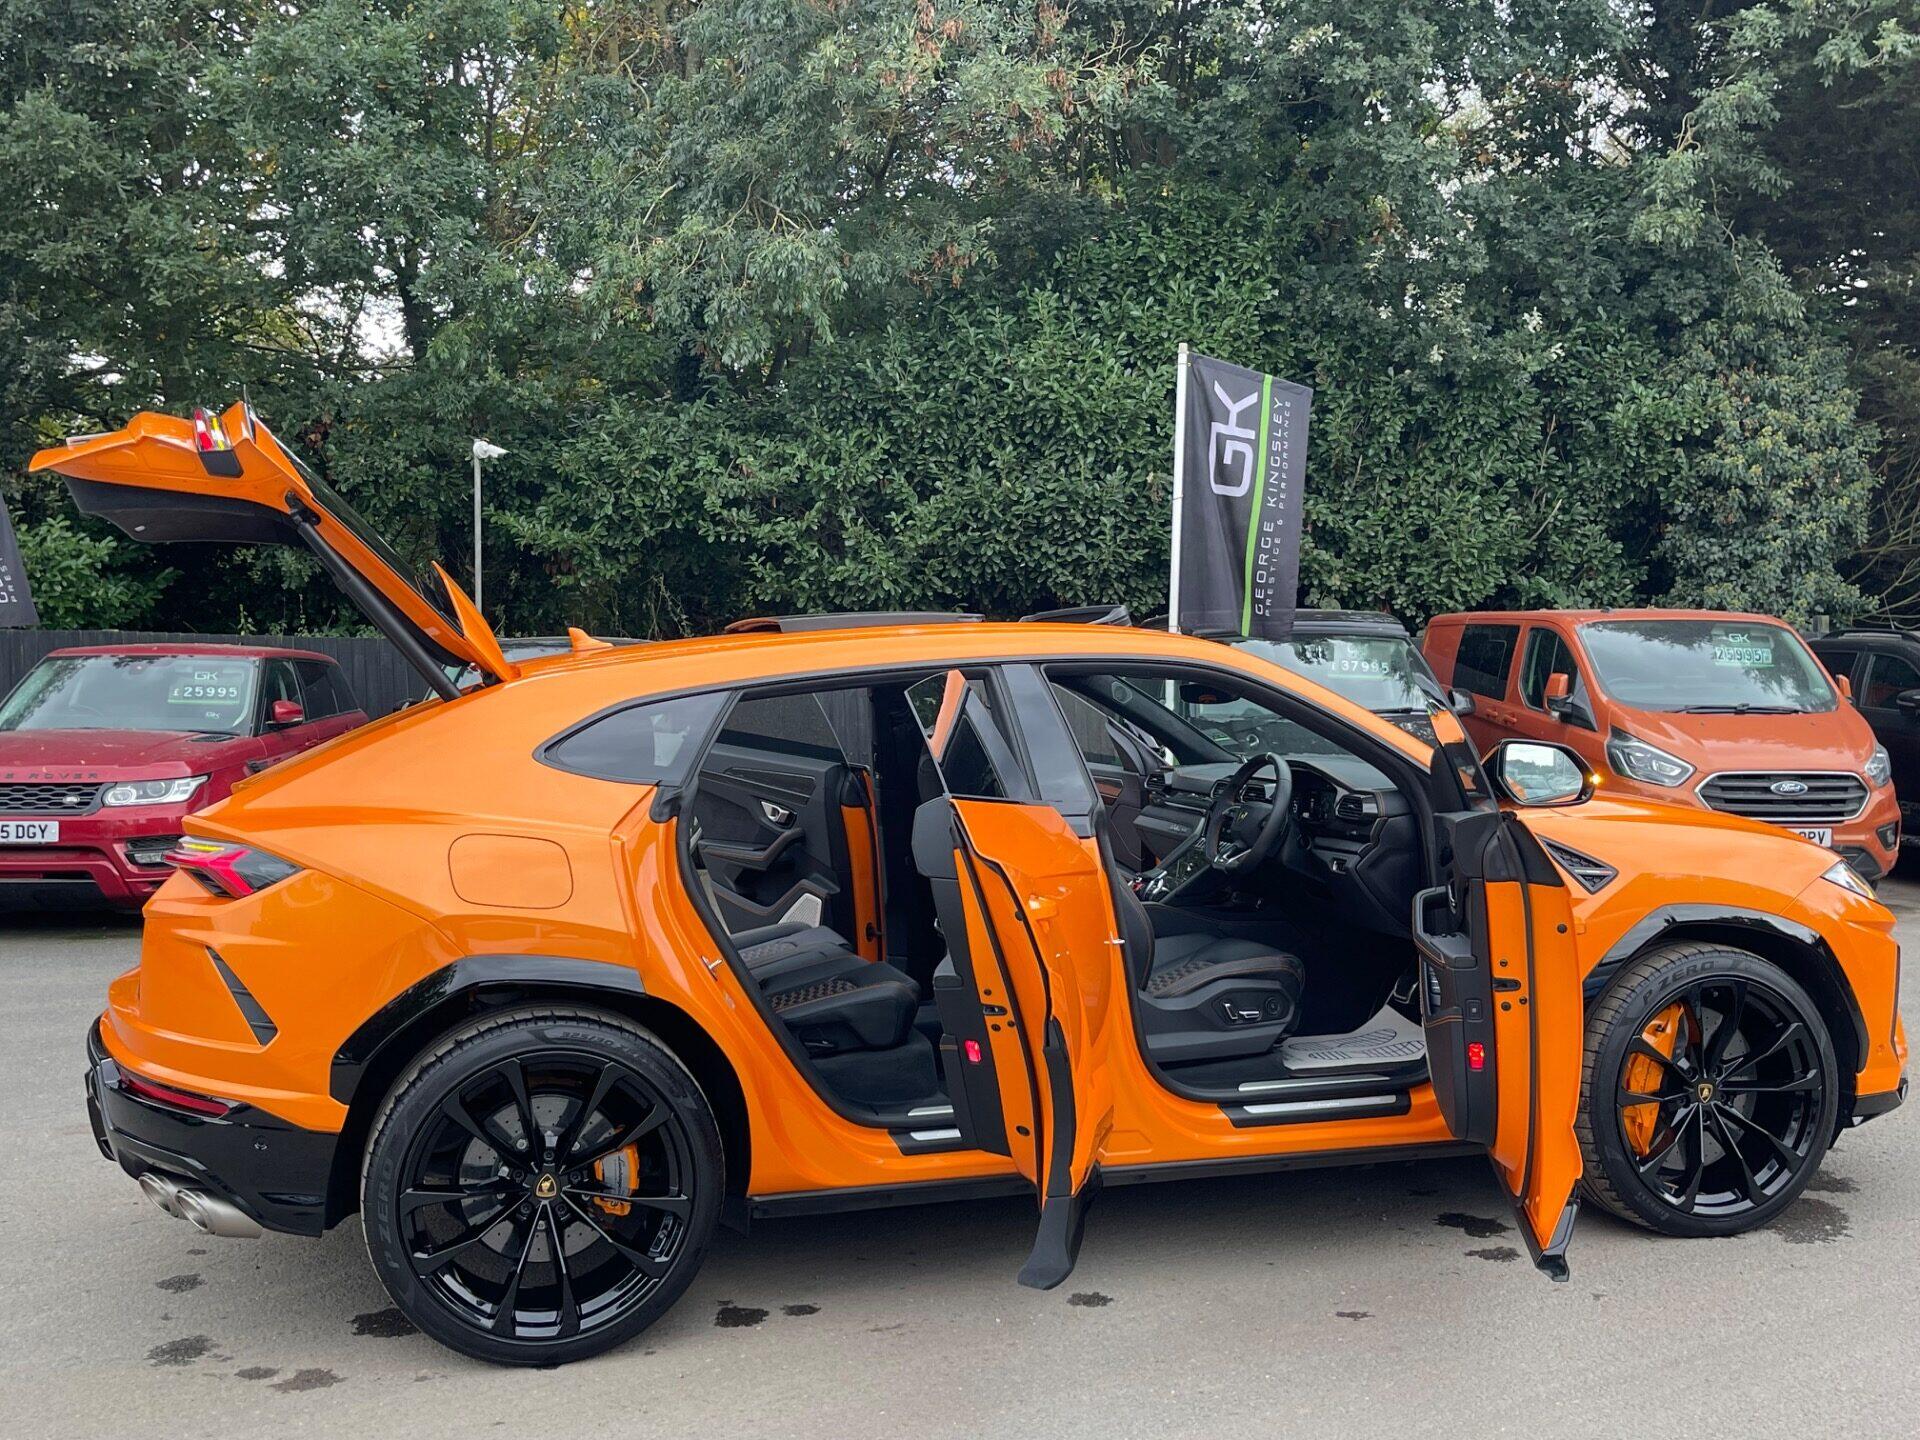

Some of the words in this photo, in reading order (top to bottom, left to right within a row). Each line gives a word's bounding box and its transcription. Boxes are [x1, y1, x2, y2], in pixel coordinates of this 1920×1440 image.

[1209, 380, 1258, 497] GK
[1255, 521, 1274, 615] GEORGE
[1266, 397, 1284, 507] KINGSLEY
[1265, 538, 1281, 616] PRESTIGE
[1279, 401, 1291, 509] PERFORMANCE
[1728, 633, 1750, 643] GK
[194, 671, 218, 680] GK
[1779, 783, 1802, 792] Ford
[16, 824, 48, 839] DGY
